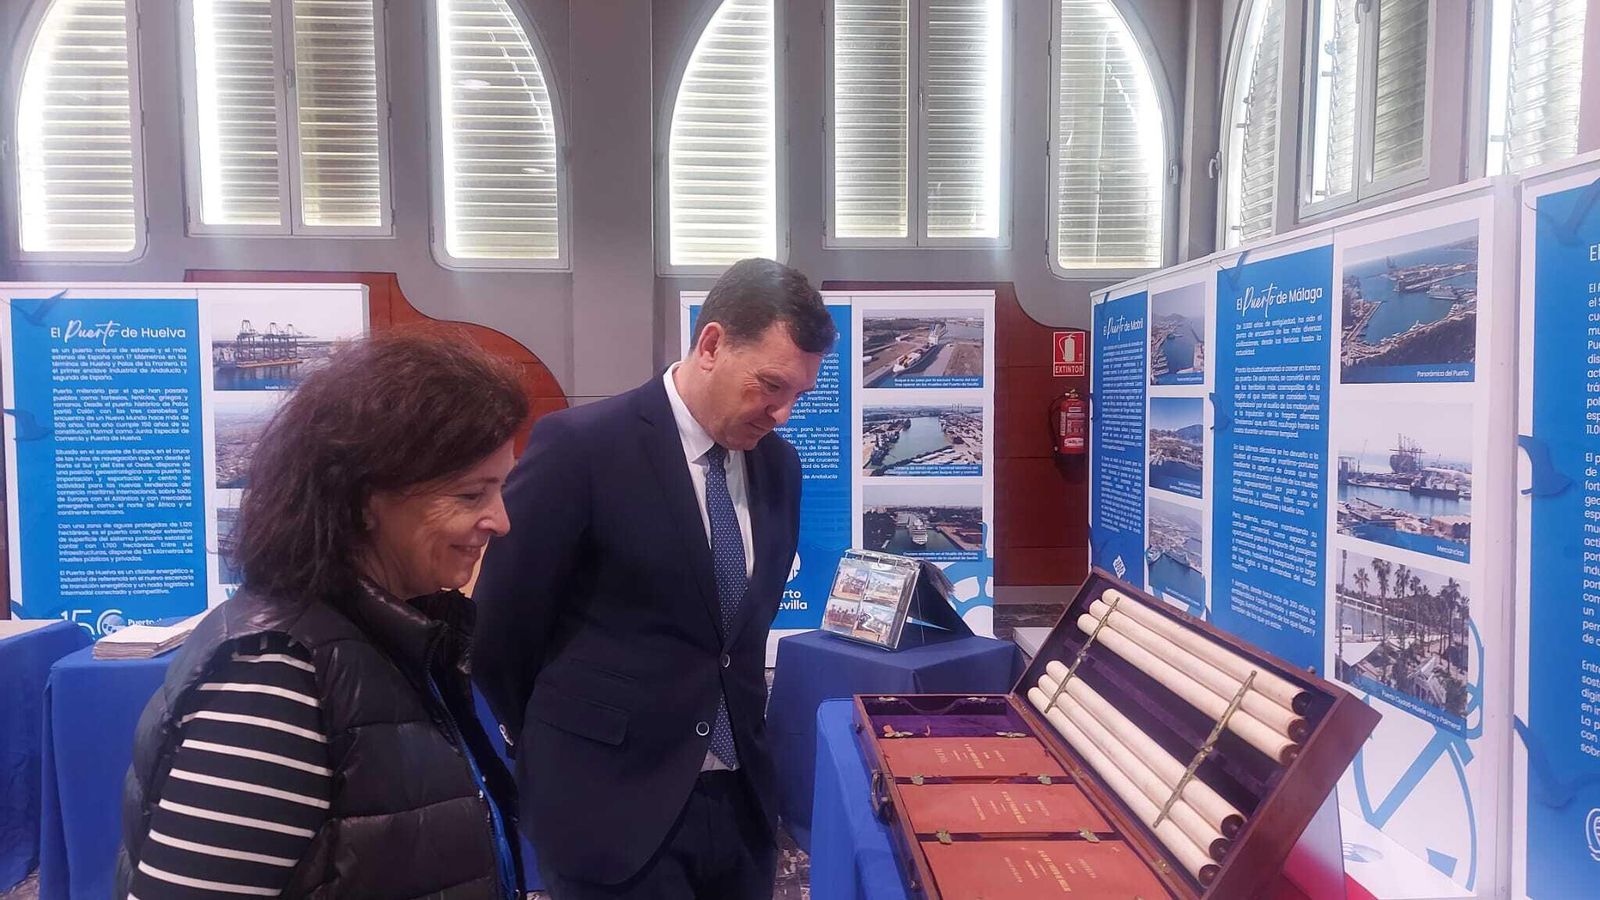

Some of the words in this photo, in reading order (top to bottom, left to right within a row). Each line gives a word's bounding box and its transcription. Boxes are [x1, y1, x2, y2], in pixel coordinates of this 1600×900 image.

[1236, 297, 1242, 310] El
[1242, 283, 1278, 318] Puerto
[1276, 290, 1288, 304] de
[1288, 288, 1322, 304] Málaga
[1588, 298, 1596, 307] el
[50, 327, 60, 338] El
[64, 320, 120, 346] Puerto
[121, 327, 138, 338] de
[141, 327, 186, 338] Huelva
[1056, 365, 1083, 374] EXTINTOR
[1586, 452, 1592, 462] El
[1585, 467, 1597, 476] de
[778, 600, 807, 610] evilla
[1583, 606, 1594, 616] un
[1582, 633, 1594, 644] de
[1581, 702, 1592, 713] en
[1581, 730, 1597, 742] con
